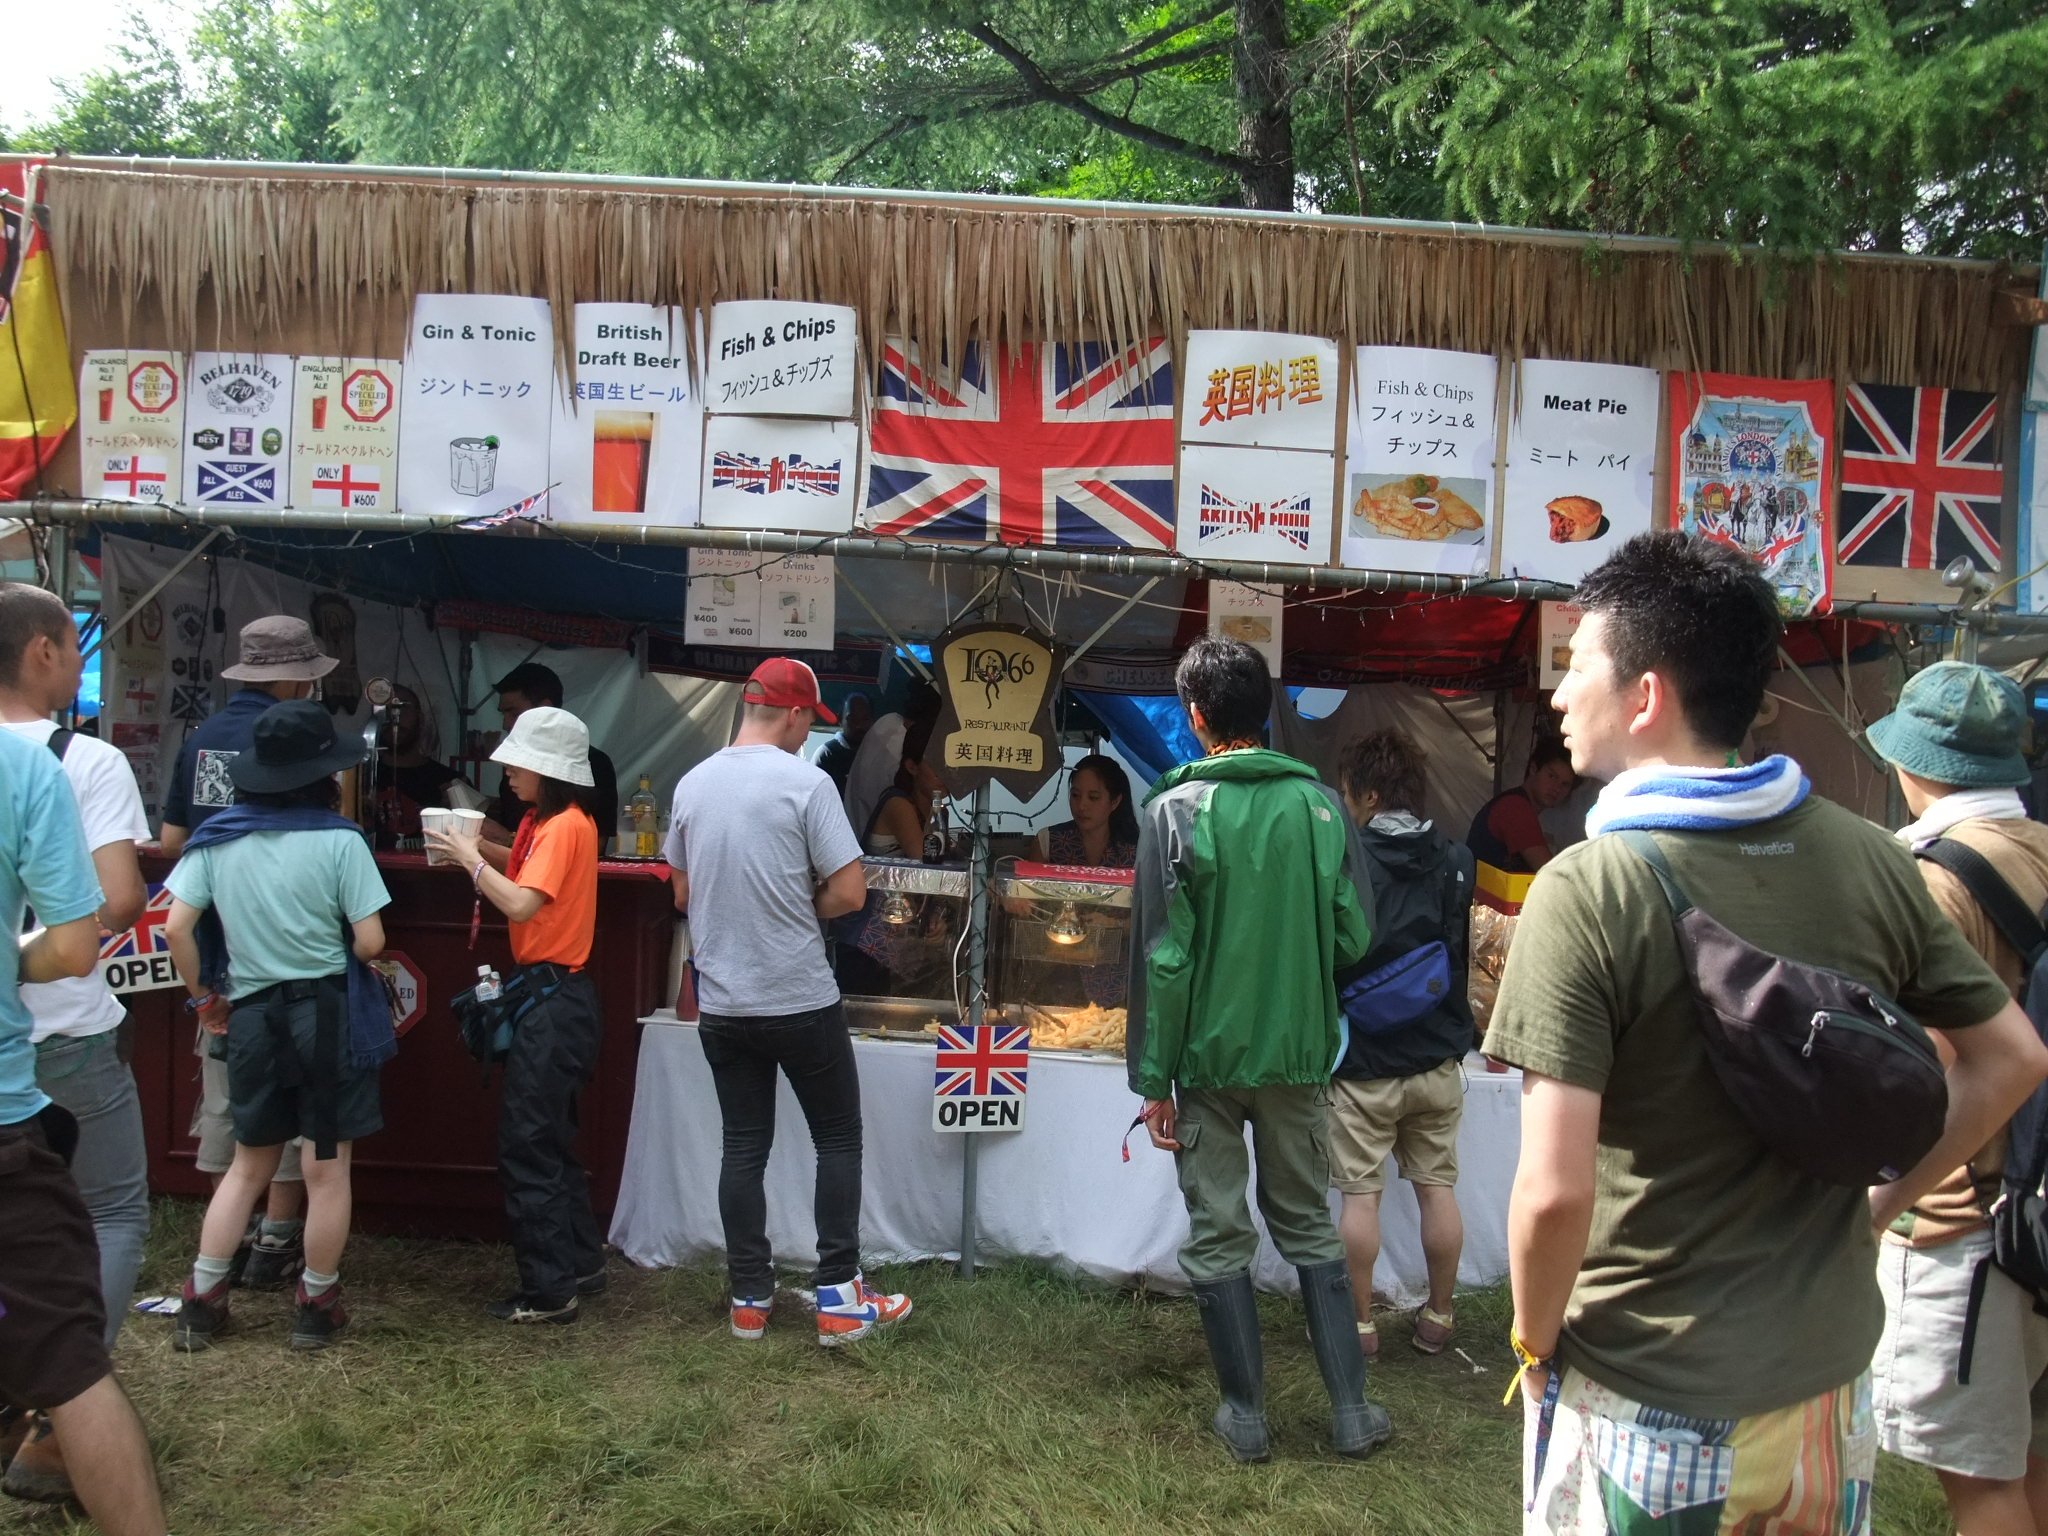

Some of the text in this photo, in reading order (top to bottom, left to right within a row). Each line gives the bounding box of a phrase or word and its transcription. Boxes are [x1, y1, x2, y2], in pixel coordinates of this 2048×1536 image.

[422, 324, 536, 342] Gin & Tonic
[597, 324, 663, 341] British
[721, 318, 836, 361] Fish & Chips
[89, 358, 127, 366] ENGLANDS
[578, 351, 681, 369] Draft Beer
[302, 364, 342, 373] ENGLANDS
[200, 363, 282, 389] BELHAVEN
[314, 382, 328, 390] ALE
[420, 378, 532, 398] ジントニック
[1200, 354, 1323, 427] 英国料理
[1377, 380, 1474, 402] Fish & Chips
[349, 390, 386, 399] SPECKLED
[1543, 394, 1628, 414] Meat Pie
[1371, 406, 1475, 428] フィッシュ&
[198, 436, 219, 444] BEST
[1387, 437, 1458, 458] チップス
[1722, 441, 1737, 473] FAMOUS
[1736, 432, 1772, 446] LONDON
[108, 459, 129, 471] ONLY
[1530, 447, 1631, 471] ミート パイ
[225, 464, 247, 473] GUEST
[317, 467, 340, 479] ONLY
[203, 476, 216, 485] ALL
[253, 478, 272, 489] ¥600
[140, 484, 162, 496] ¥600
[226, 491, 244, 500] ALES
[353, 494, 376, 506] ¥600
[1199, 483, 1311, 551] BRITISH FOOD
[783, 561, 815, 571] Drinks
[694, 614, 717, 623] ¥400
[729, 627, 752, 636] ¥600
[784, 629, 807, 638] ¥200
[959, 648, 1034, 683] 1066
[965, 719, 1030, 731] RESTAURANT
[955, 743, 1032, 764] 英国料理
[1738, 841, 1794, 855] Helvetica
[938, 1100, 1020, 1126] OPEN
